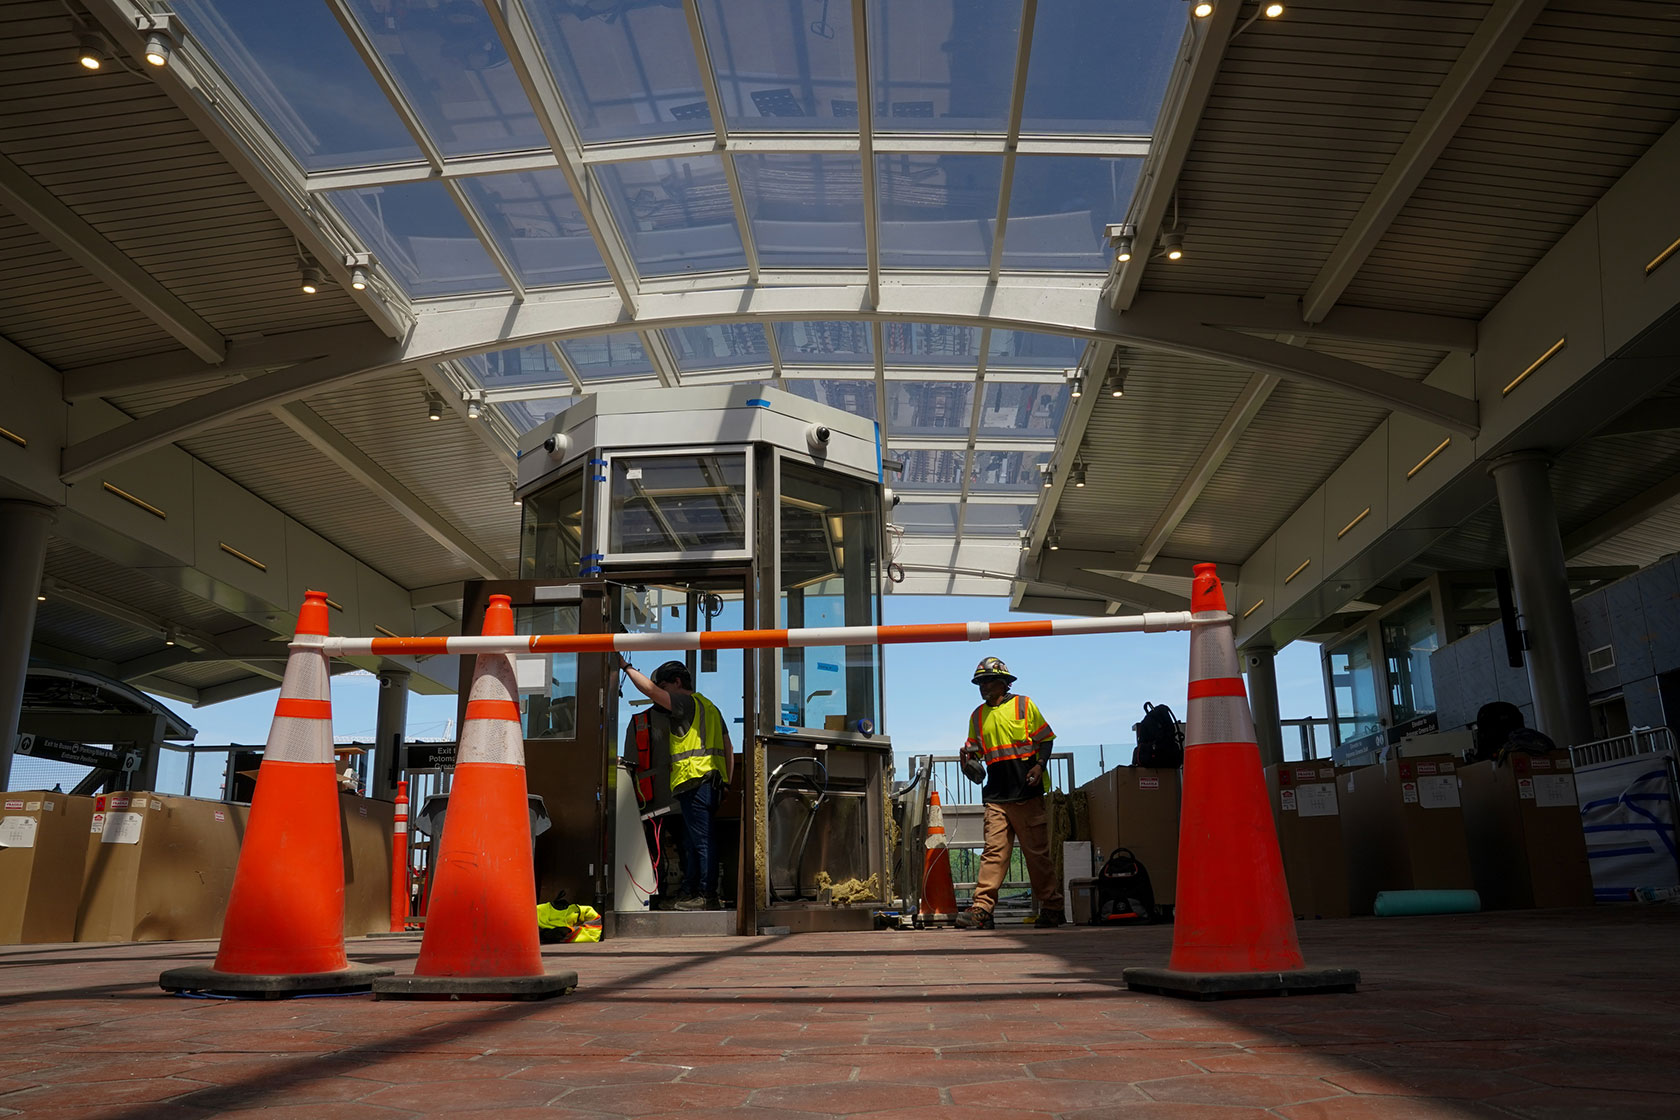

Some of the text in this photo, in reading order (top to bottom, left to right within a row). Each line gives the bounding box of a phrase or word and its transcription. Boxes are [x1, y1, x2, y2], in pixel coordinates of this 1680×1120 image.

[43, 739, 54, 747] Exit
[59, 742, 72, 751] Buses
[61, 751, 80, 761] Entrance
